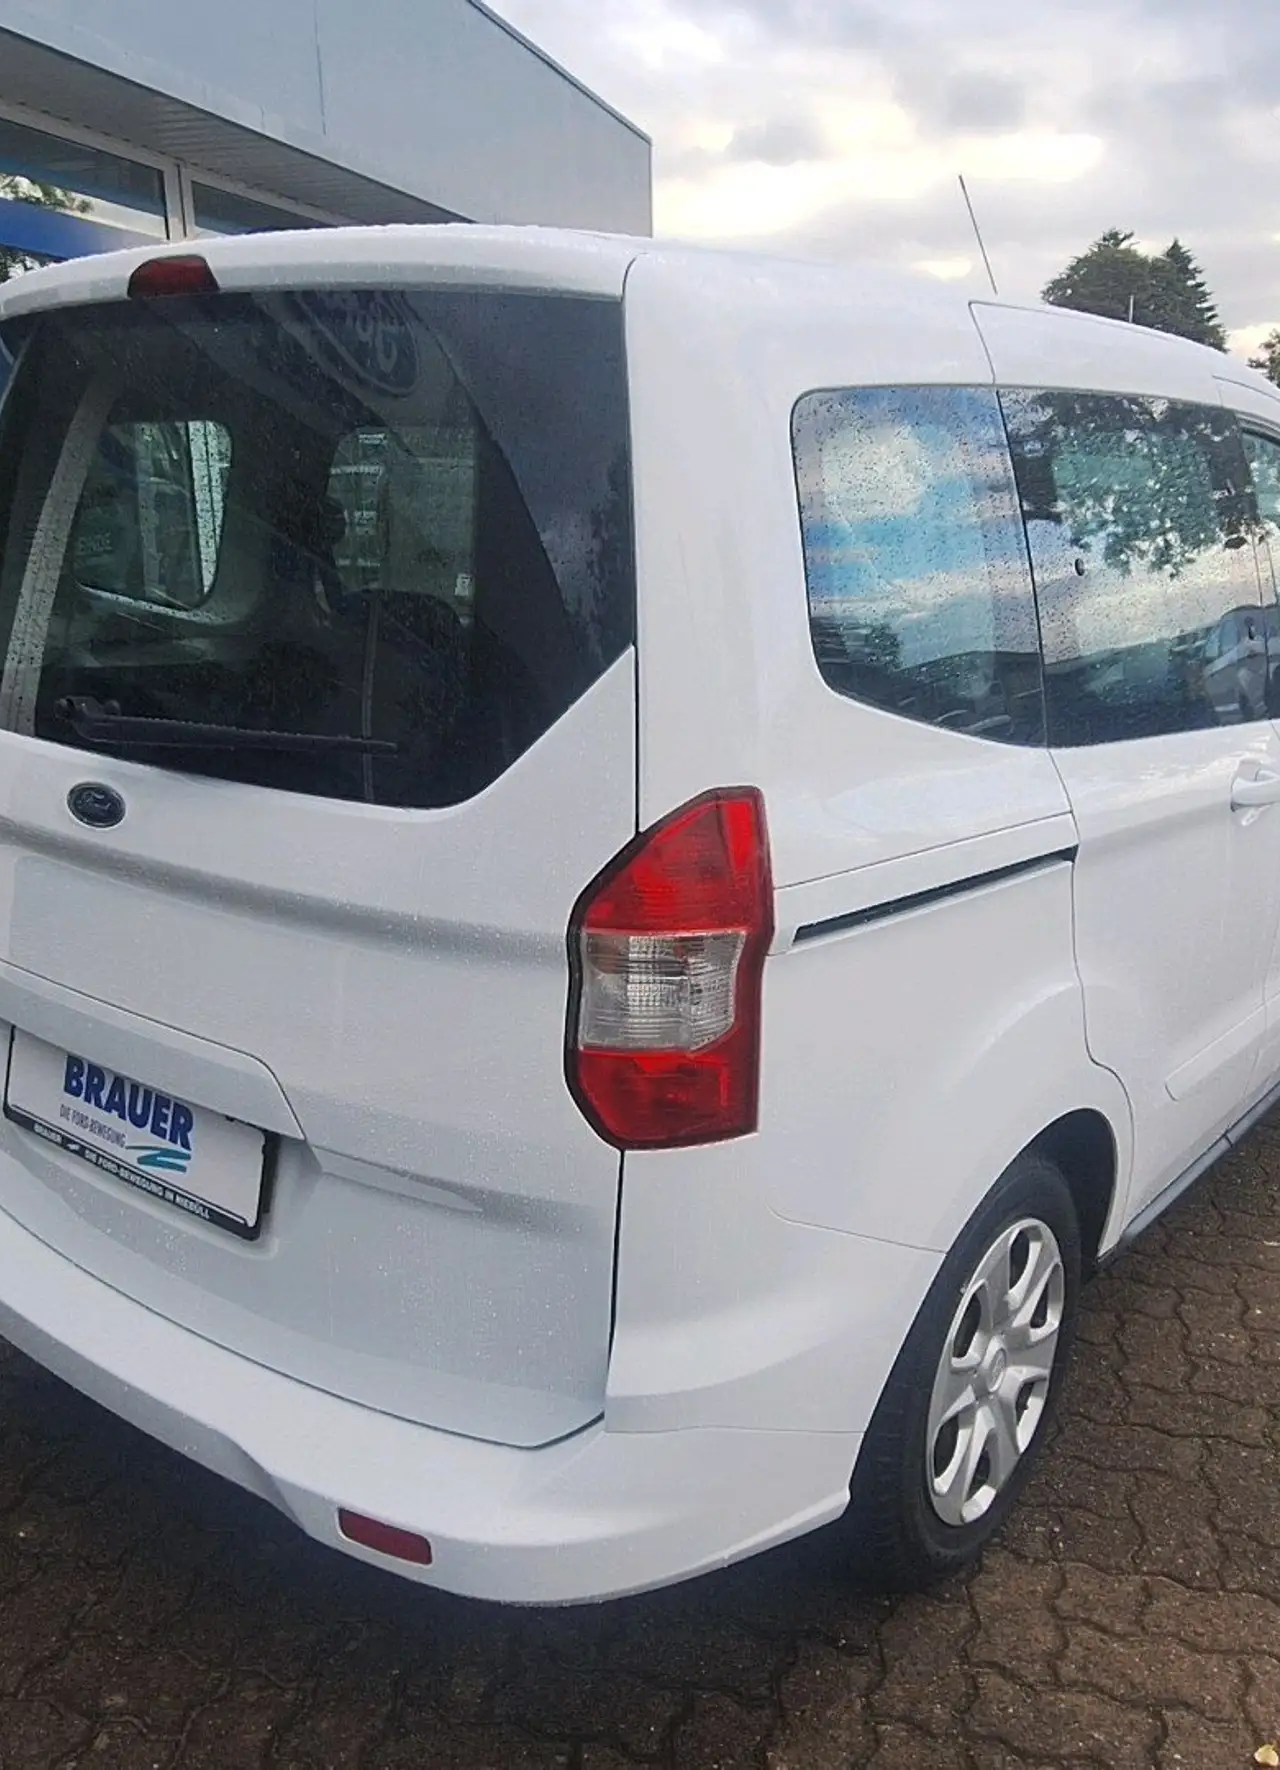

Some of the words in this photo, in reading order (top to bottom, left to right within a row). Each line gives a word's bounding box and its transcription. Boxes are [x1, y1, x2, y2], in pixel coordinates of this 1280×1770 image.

[64, 1054, 194, 1150] BRAUER
[33, 1122, 62, 1144] BRAUER
[60, 1103, 71, 1121] DIE
[72, 1109, 126, 1148] FORD-BEWEGUNG
